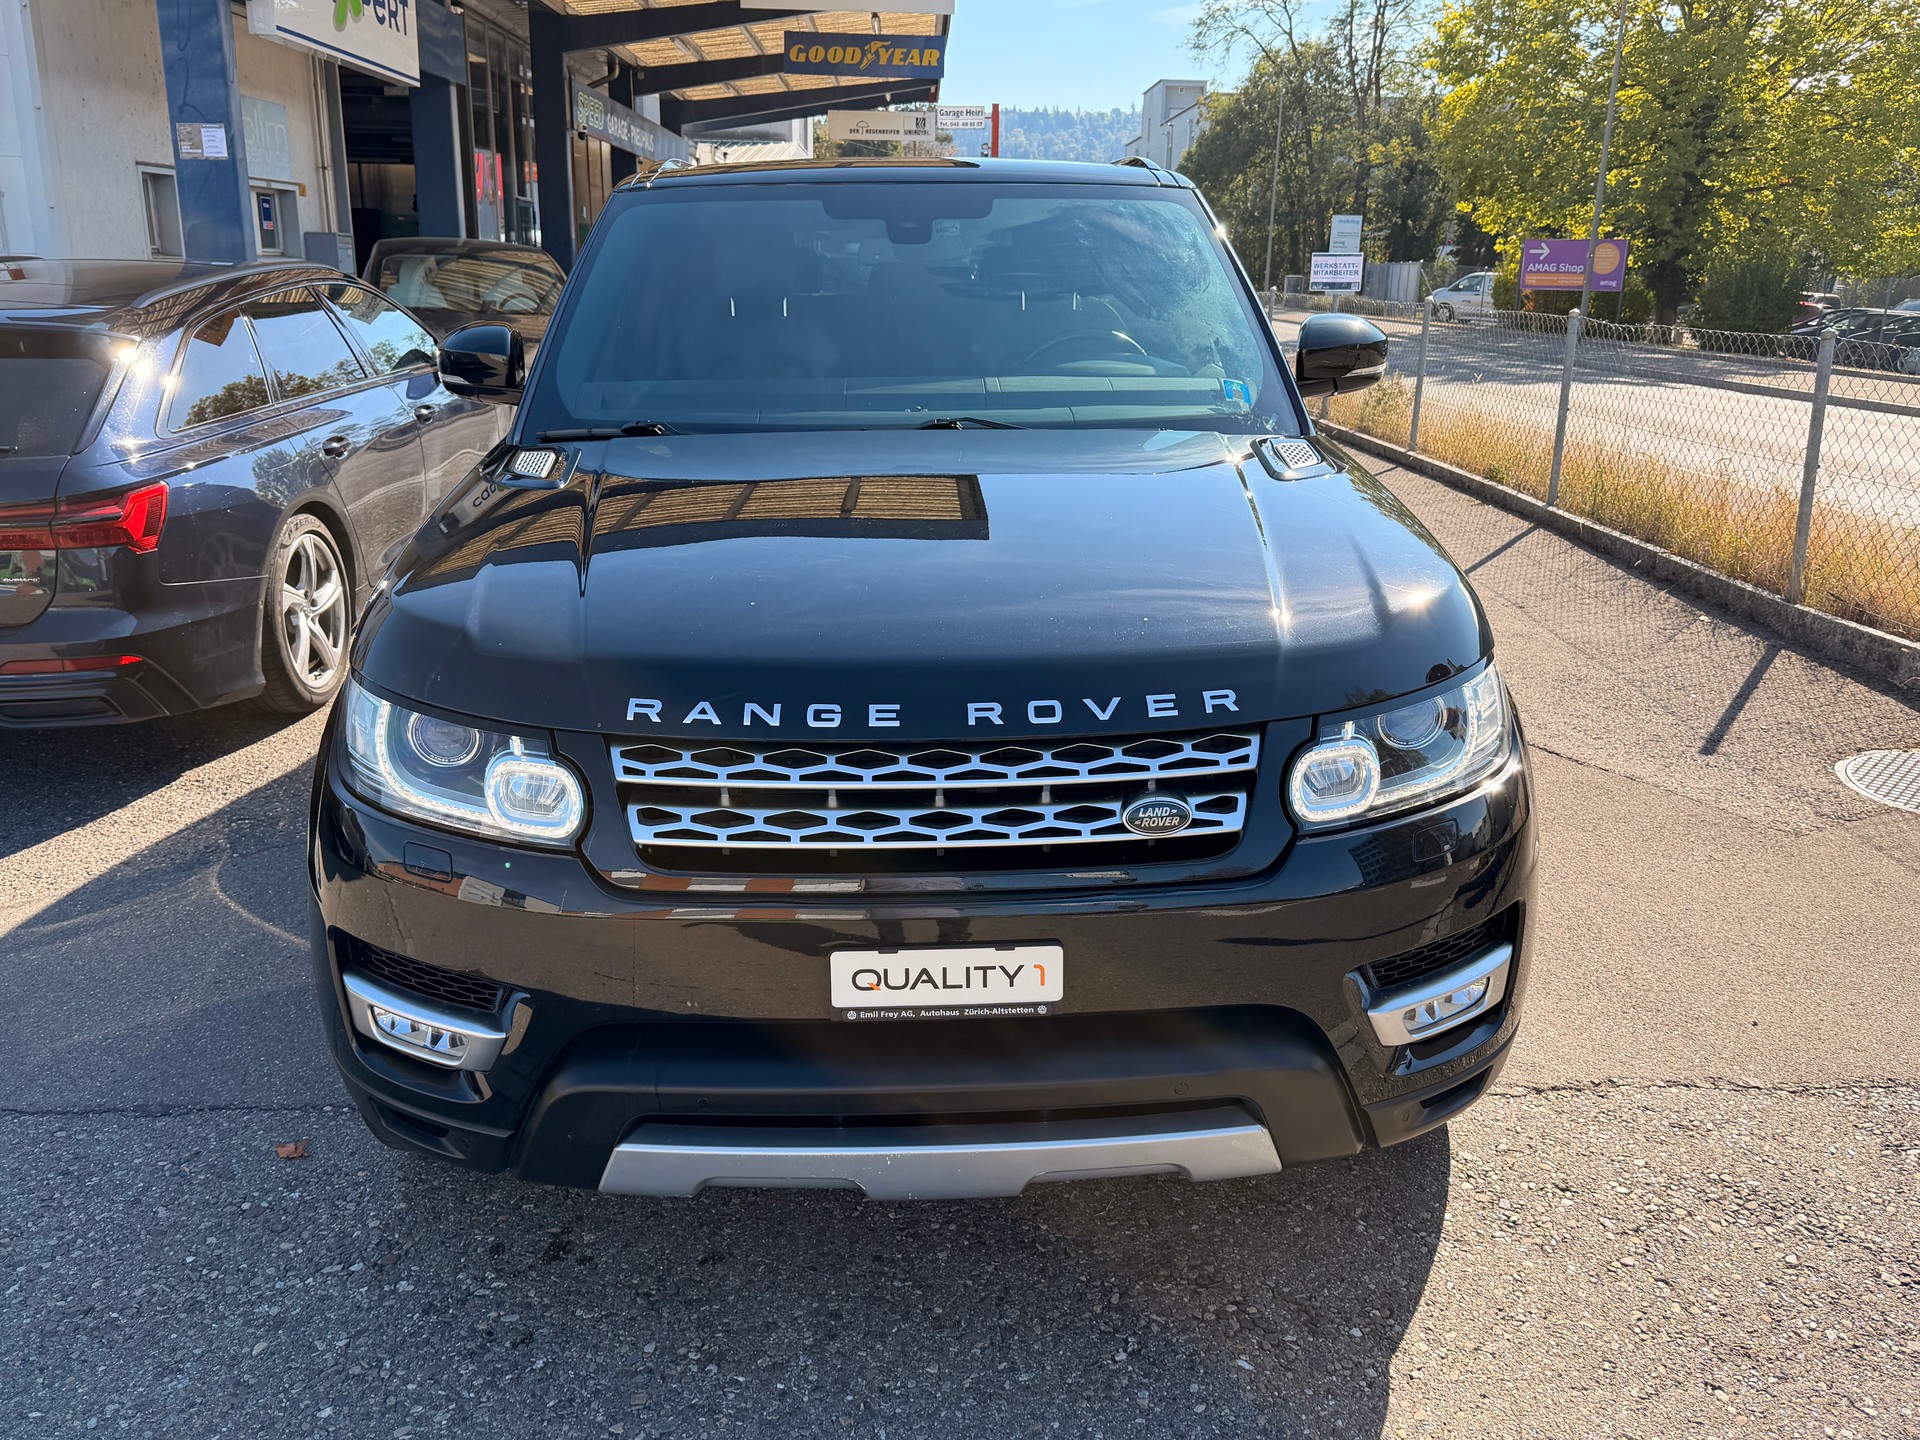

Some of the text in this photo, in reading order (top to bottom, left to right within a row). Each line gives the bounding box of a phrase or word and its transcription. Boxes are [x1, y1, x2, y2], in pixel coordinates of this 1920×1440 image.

[577, 91, 604, 130] SPEED
[939, 108, 984, 118] Garage Heiri
[1527, 263, 1584, 274] AMAG Shop
[626, 689, 1239, 728] RANGE ROVER
[1138, 806, 1170, 818] LAND
[1142, 815, 1180, 828] ROVER
[851, 963, 1046, 991] QUALITY 1
[860, 1005, 1034, 1020] Emil Frey AG, Autohaus Zürich-Altstetten
